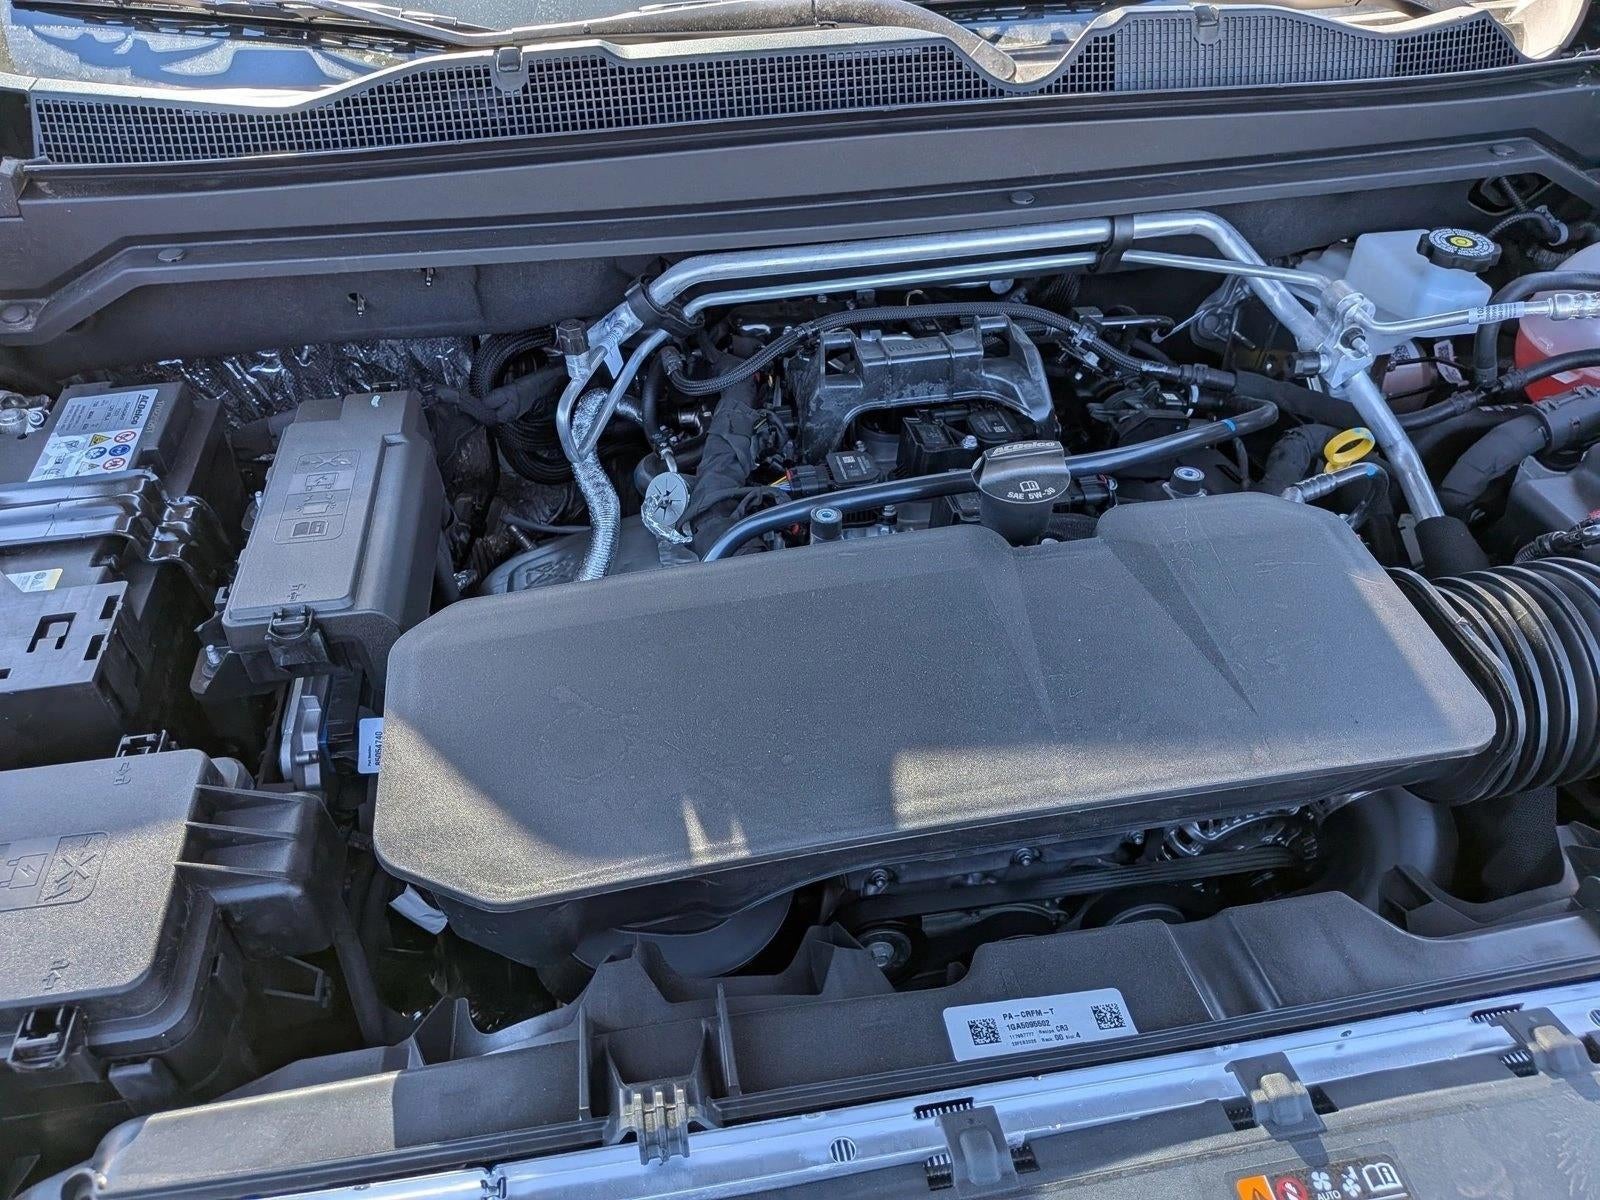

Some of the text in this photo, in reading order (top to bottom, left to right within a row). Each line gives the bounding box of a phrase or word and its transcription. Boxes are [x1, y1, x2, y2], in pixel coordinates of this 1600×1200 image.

[131, 394, 150, 425] ACDelco
[991, 442, 1055, 457] ACDelco
[1007, 486, 1056, 500] SAE 5W-30
[1055, 1024, 1069, 1033] CR3
[1317, 1190, 1341, 1200] AUTO
